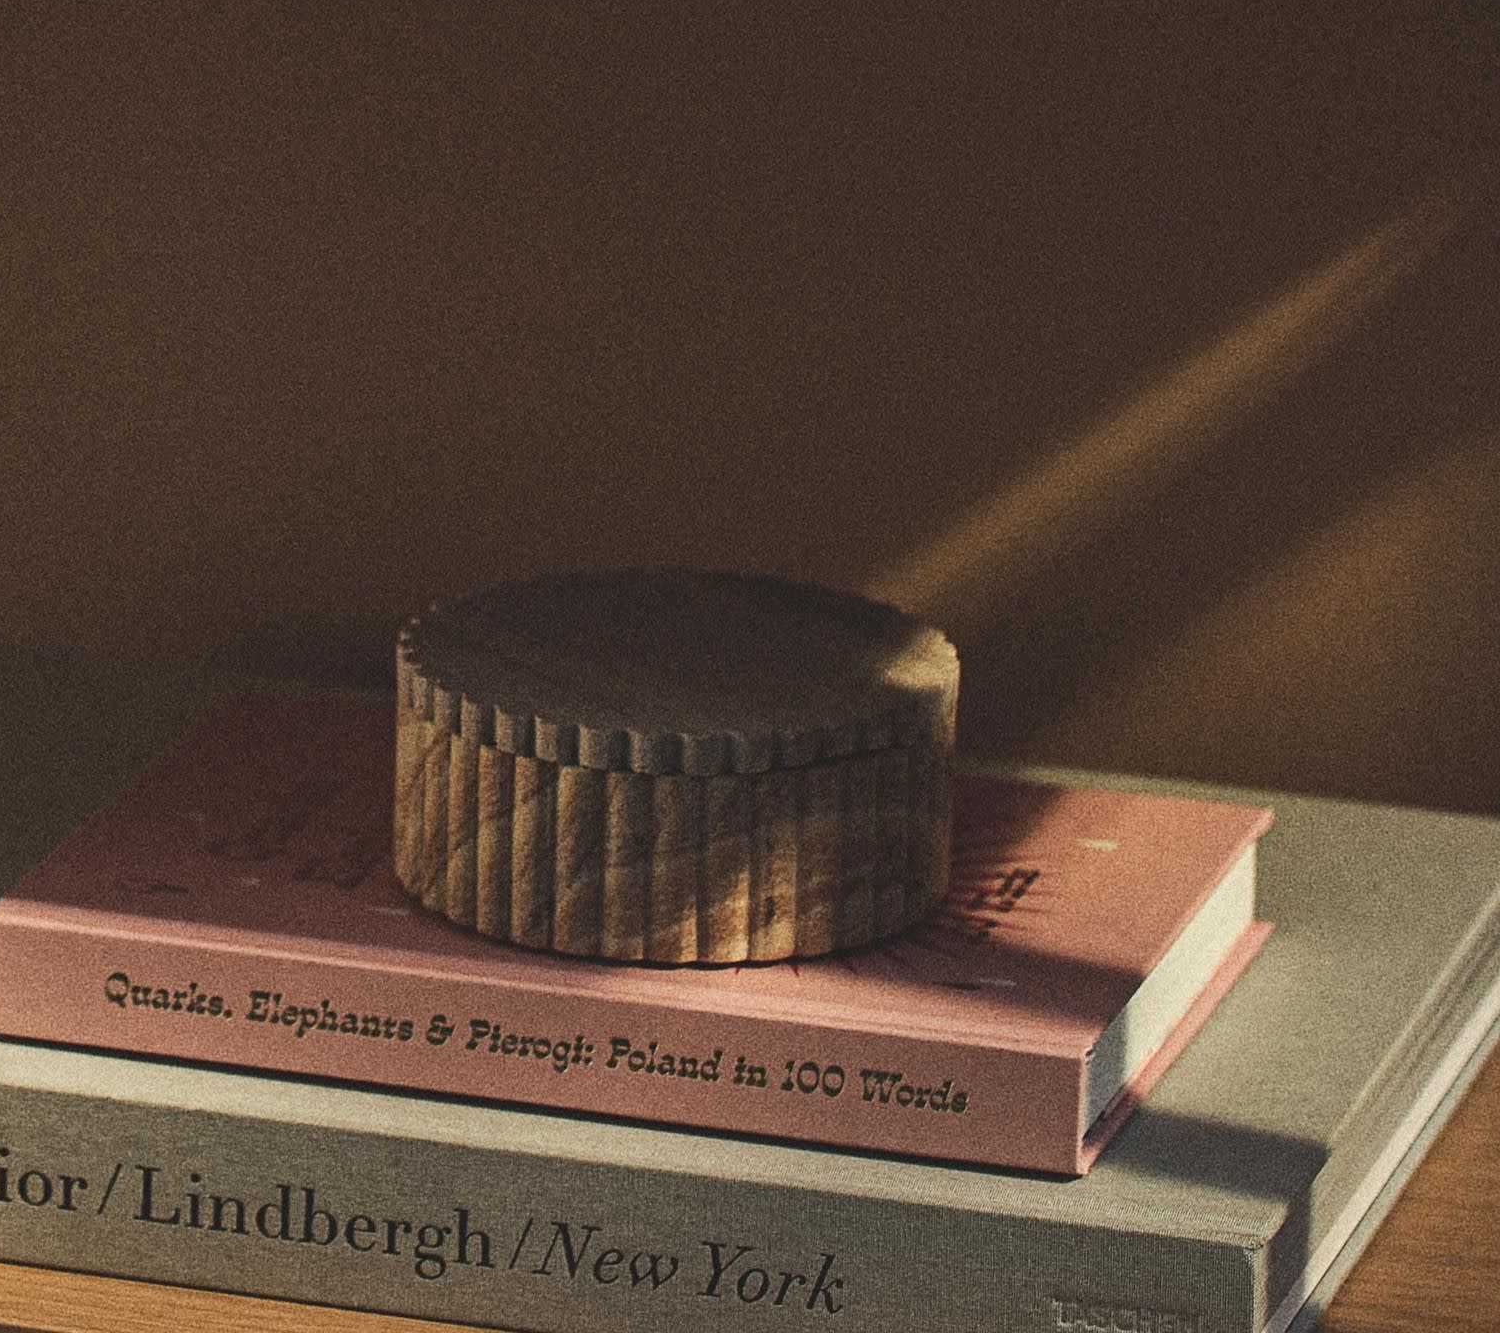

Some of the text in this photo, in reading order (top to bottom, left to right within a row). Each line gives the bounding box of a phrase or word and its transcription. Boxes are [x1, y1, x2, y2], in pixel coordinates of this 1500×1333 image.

[244, 989, 414, 1043] Elephants
[424, 1014, 456, 1046] &
[464, 1017, 595, 1074] Pierogi:
[604, 1035, 723, 1083] Poland
[732, 1056, 768, 1088] in
[778, 1059, 847, 1099] 100
[859, 1068, 970, 1115] Words
[133, 1164, 495, 1281] Lindbergh
[532, 1220, 680, 1291] New
[700, 1240, 845, 1314] York
